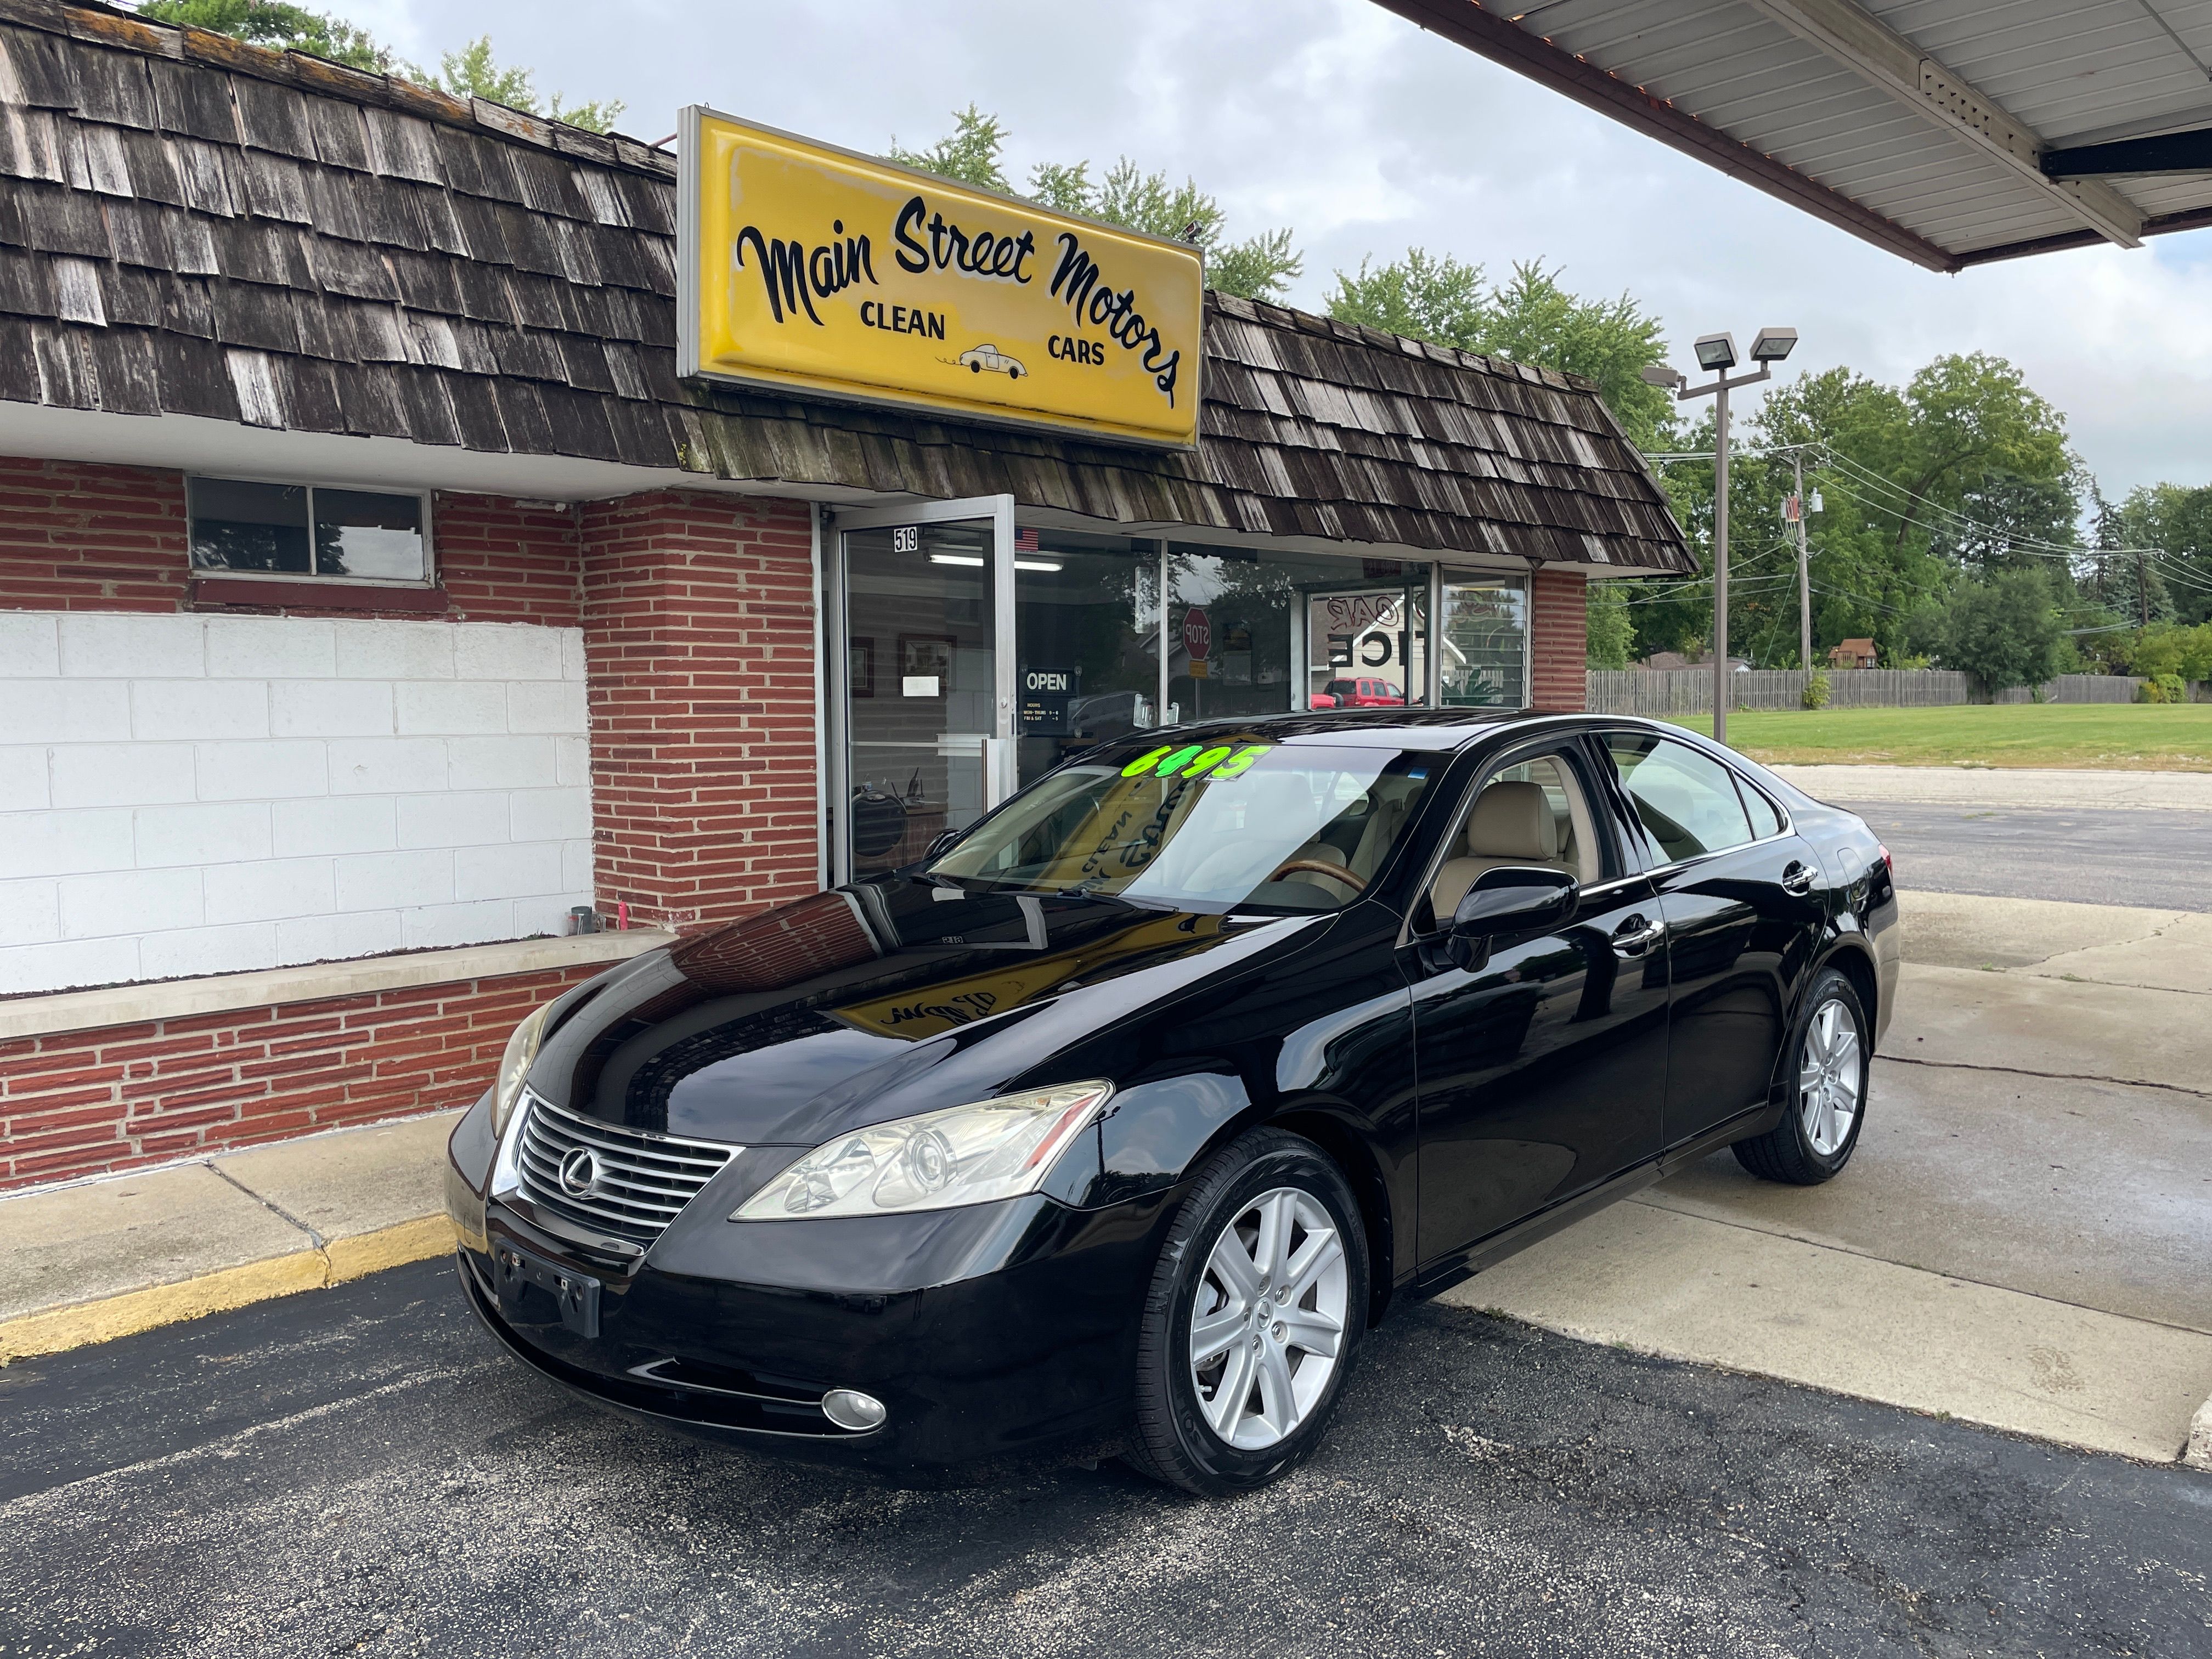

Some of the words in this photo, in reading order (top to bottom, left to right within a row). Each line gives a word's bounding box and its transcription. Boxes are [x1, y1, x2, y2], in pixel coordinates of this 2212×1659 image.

[737, 220, 879, 326] Main
[894, 195, 1035, 284] Street
[1050, 232, 1180, 409] Motors
[861, 301, 945, 340] CLEAN
[1047, 334, 1104, 366] CARS
[895, 528, 917, 551] 519
[1026, 673, 1066, 690] OPEN
[1121, 745, 1272, 779] 6495
